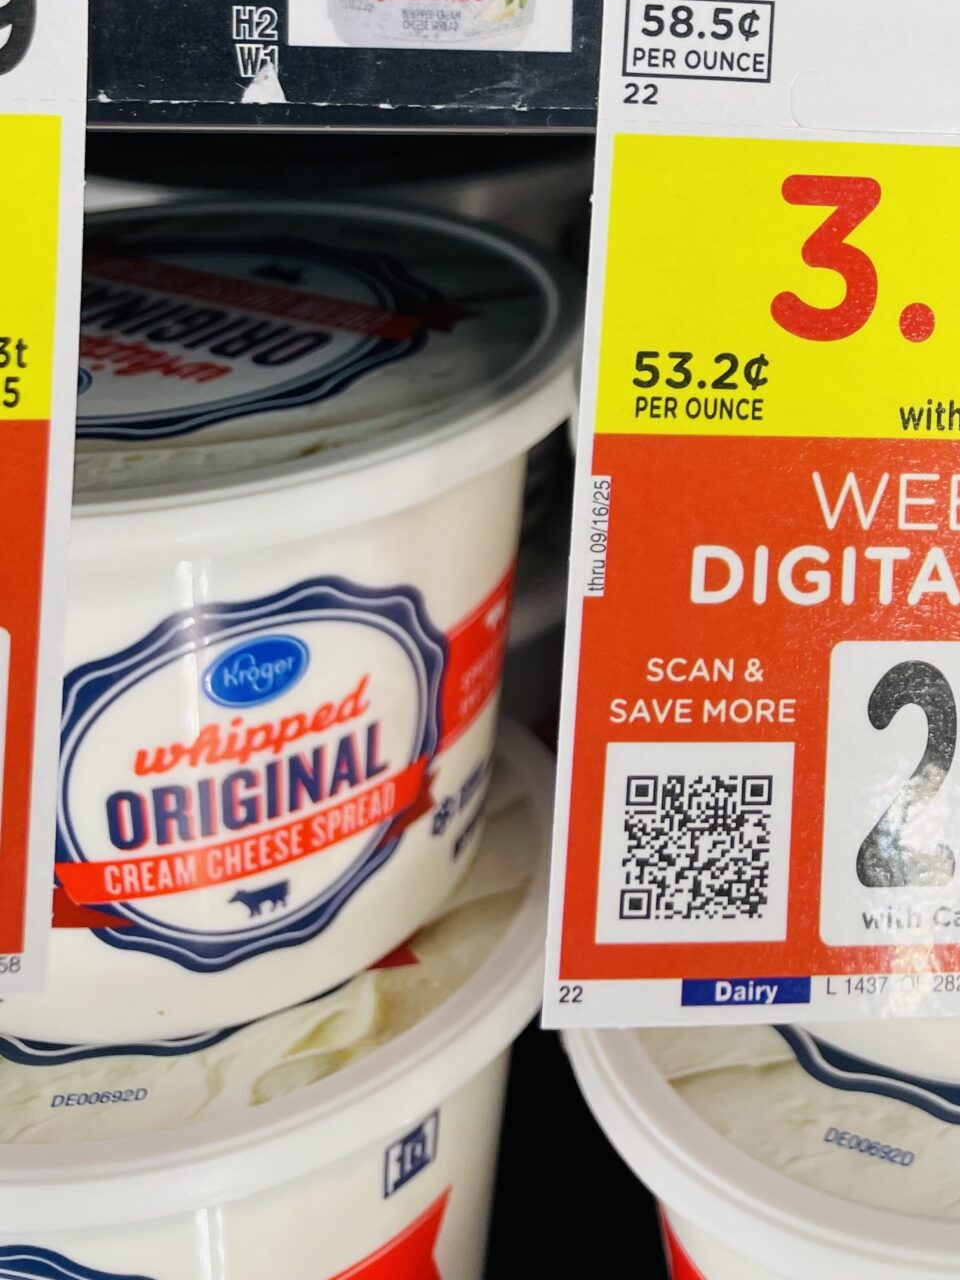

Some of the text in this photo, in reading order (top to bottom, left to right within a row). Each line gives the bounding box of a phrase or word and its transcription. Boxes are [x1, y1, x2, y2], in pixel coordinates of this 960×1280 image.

[232, 5, 278, 40] H2
[640, 5, 760, 42] 58.5¢
[632, 48, 767, 75] PER OUNCE
[623, 83, 659, 107] 22
[632, 350, 770, 392] 53.2¢
[634, 396, 764, 422] PER OUNCE
[587, 480, 611, 592] thru 09/16/25
[222, 653, 296, 692] Kroger
[645, 657, 765, 684] SCAN &
[608, 698, 797, 725] SAVE MORE
[133, 674, 371, 777] whipped
[105, 721, 390, 851] ORIGINAL
[104, 860, 197, 897] CREAM
[206, 829, 302, 880] CHEESE
[310, 780, 396, 845] SPREAD
[862, 906, 921, 930] with
[558, 986, 584, 1004] 22
[714, 980, 778, 1005] Dairy
[827, 978, 836, 995] L
[845, 977, 888, 995] 1437
[50, 1087, 148, 1108] DE00692D
